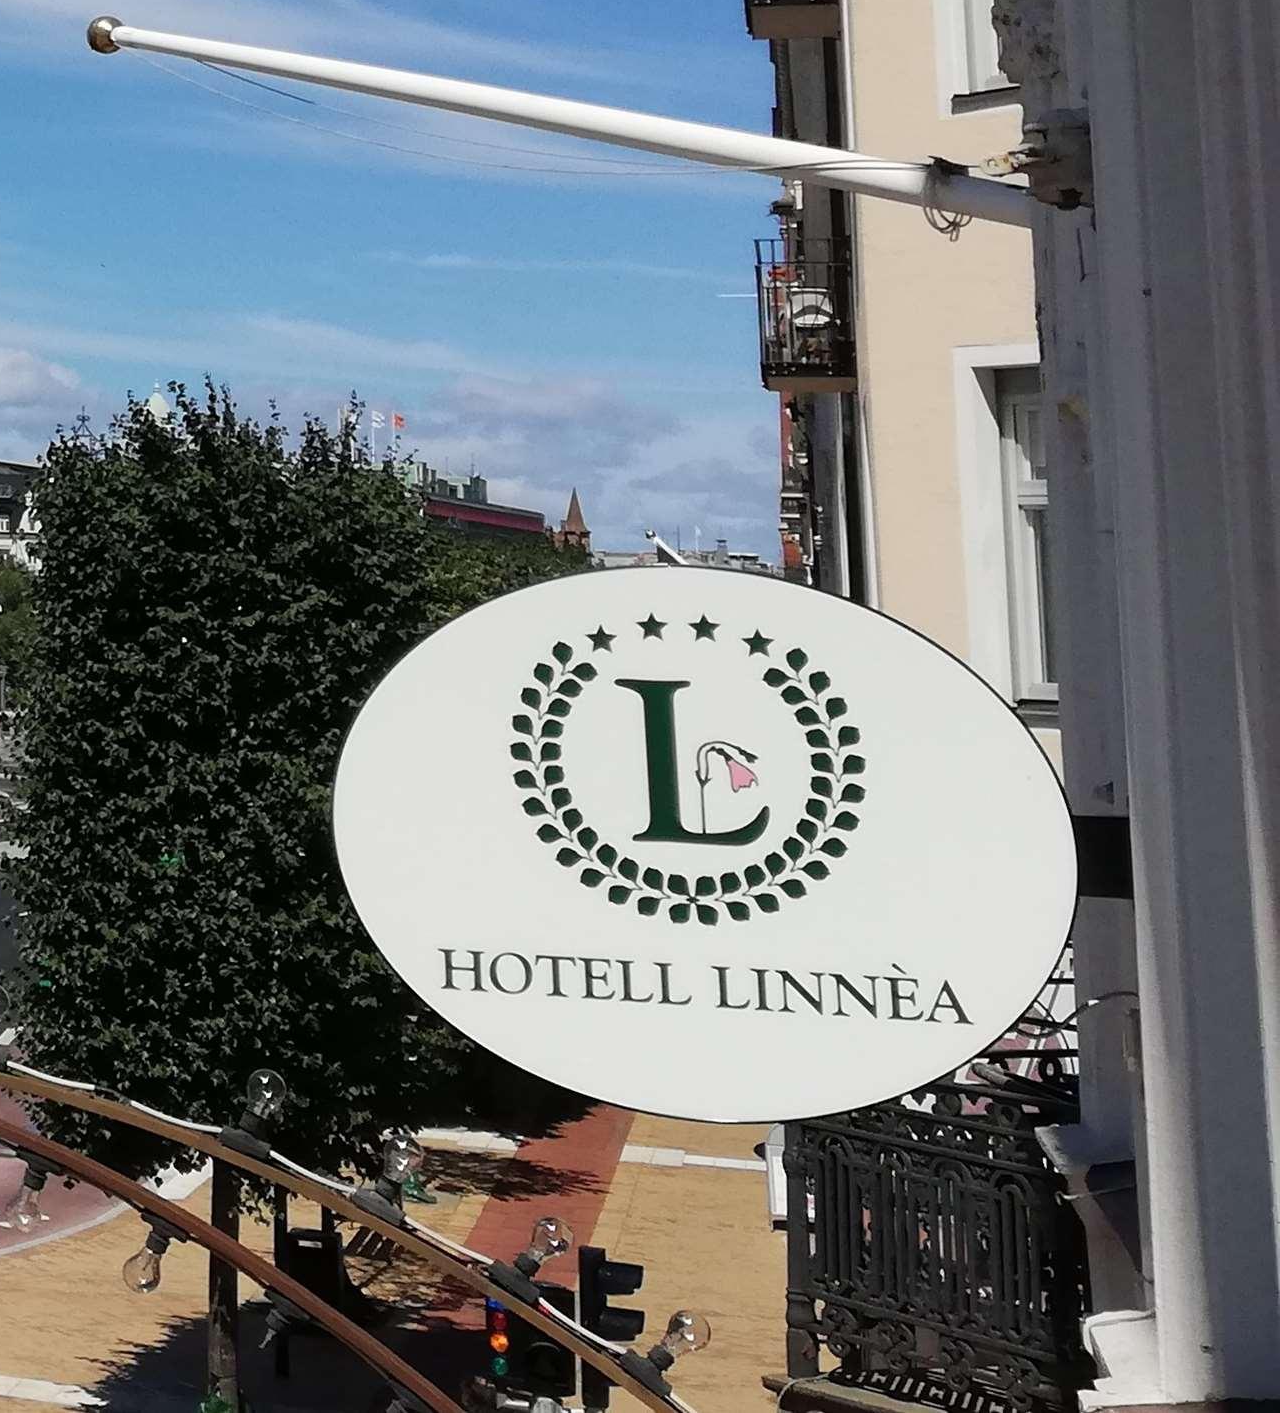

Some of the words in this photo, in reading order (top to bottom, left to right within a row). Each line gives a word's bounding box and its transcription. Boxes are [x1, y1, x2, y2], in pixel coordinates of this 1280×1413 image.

[614, 678, 771, 847] L
[437, 947, 693, 1006] HOTELL
[710, 964, 975, 1026] LINNÈA
